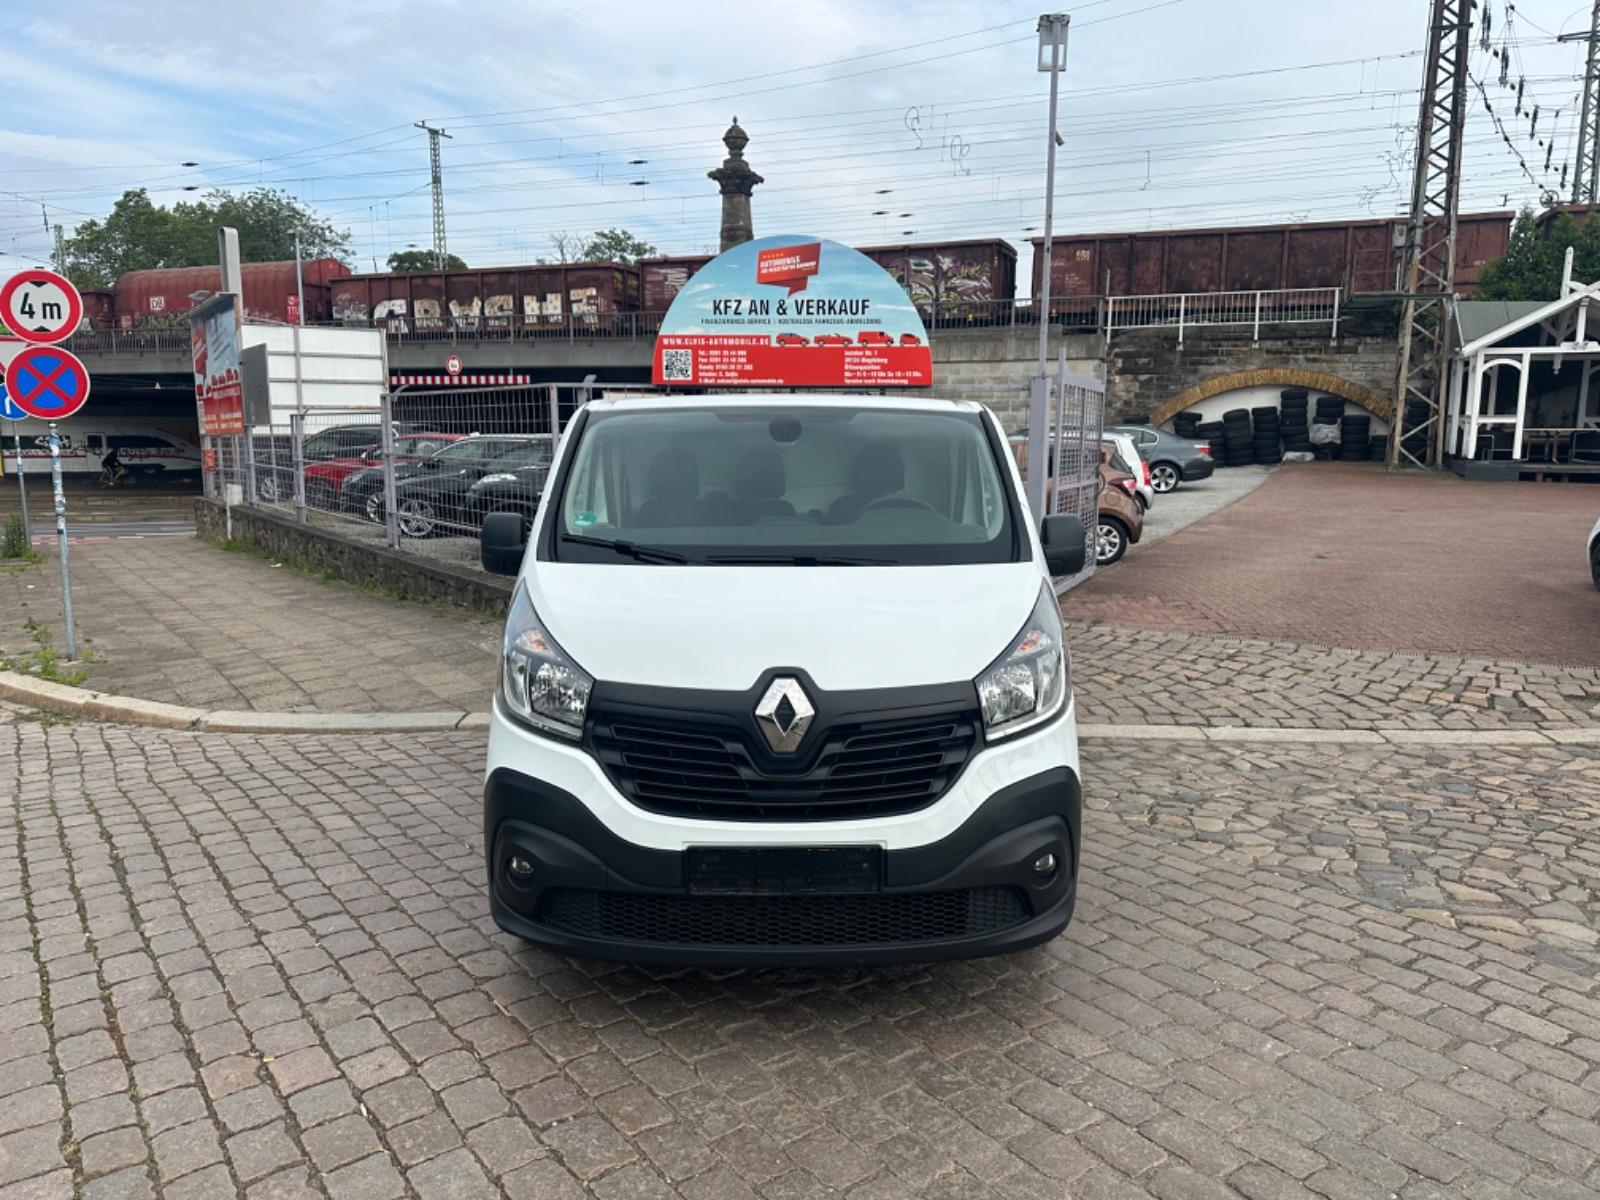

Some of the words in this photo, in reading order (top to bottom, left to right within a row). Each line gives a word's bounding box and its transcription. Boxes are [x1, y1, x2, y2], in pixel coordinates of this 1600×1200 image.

[20, 292, 35, 319] 4
[42, 302, 62, 320] m
[713, 299, 742, 316] KFZ
[748, 299, 769, 316] AN
[776, 298, 788, 316] &
[794, 299, 870, 316] VERKAUF
